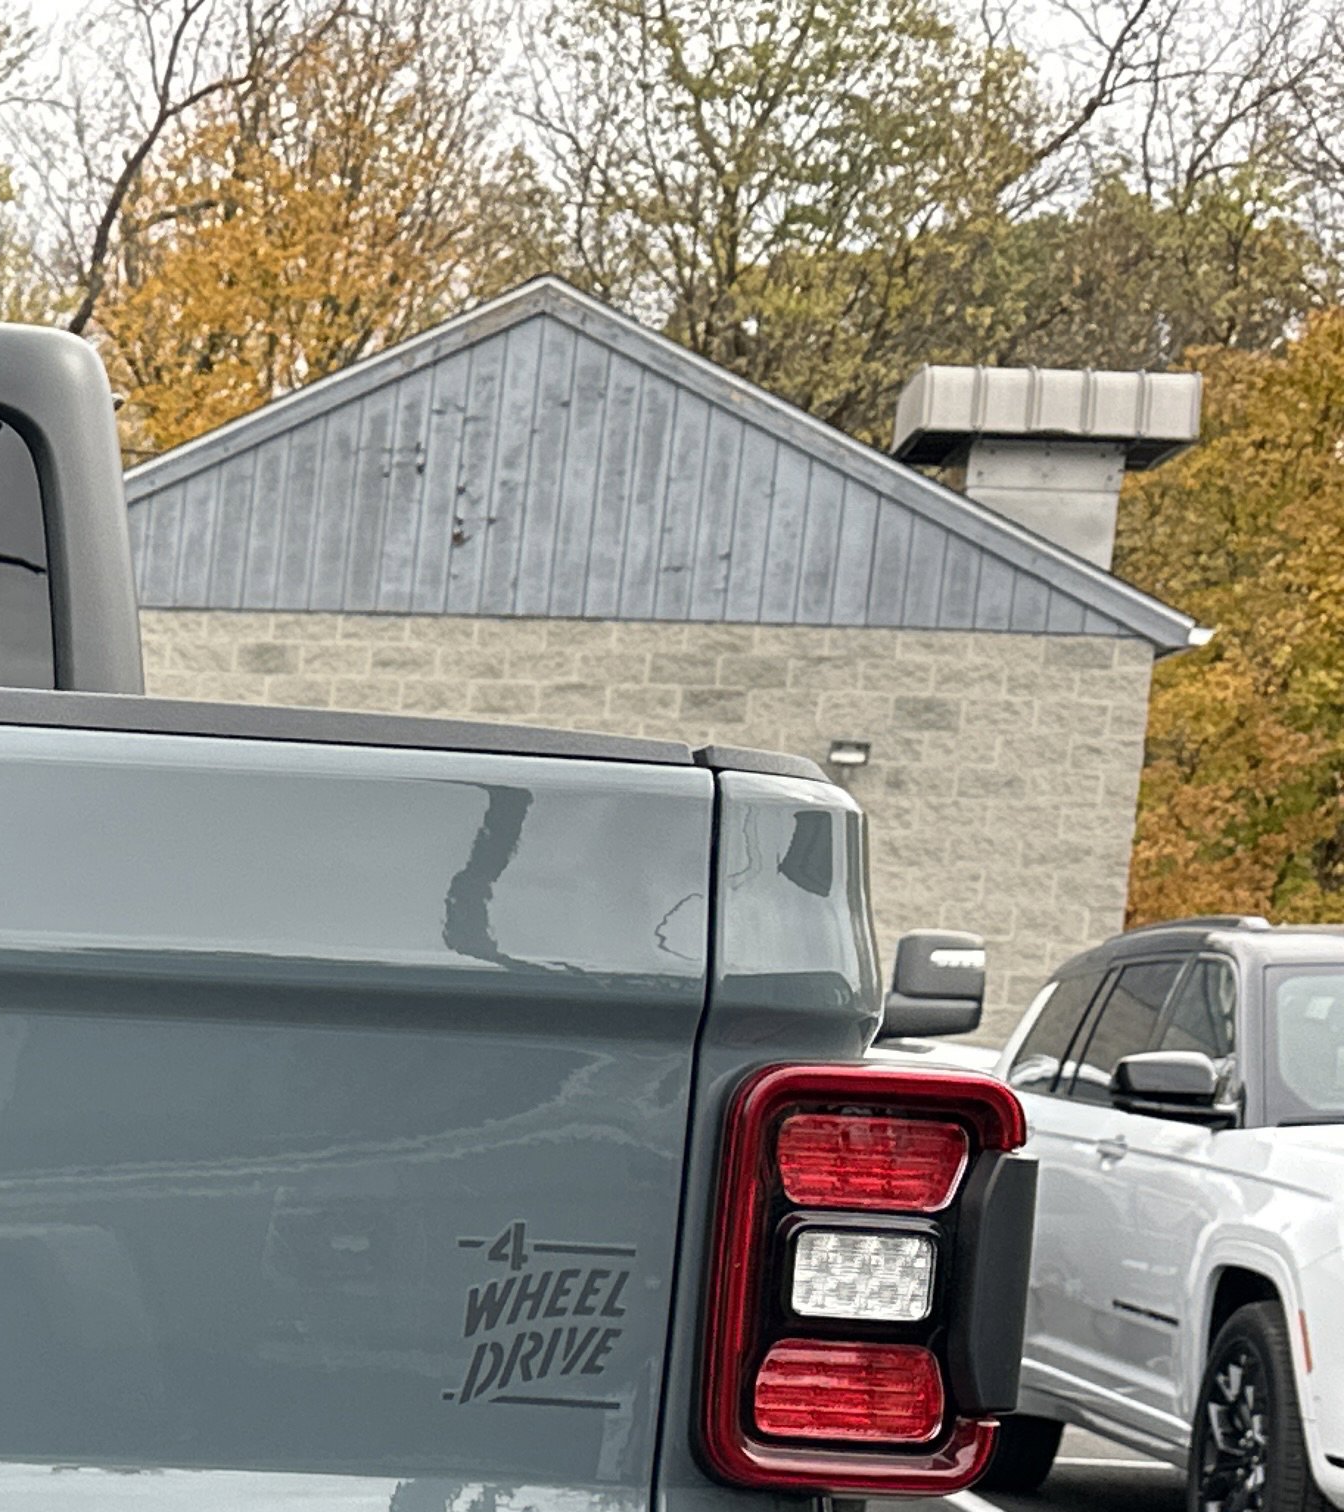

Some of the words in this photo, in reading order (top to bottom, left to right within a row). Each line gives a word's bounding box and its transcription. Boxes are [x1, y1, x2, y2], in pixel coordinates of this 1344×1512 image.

[487, 1221, 529, 1271] 4
[464, 1269, 630, 1338] WHEEL
[459, 1326, 623, 1405] DRIVE
